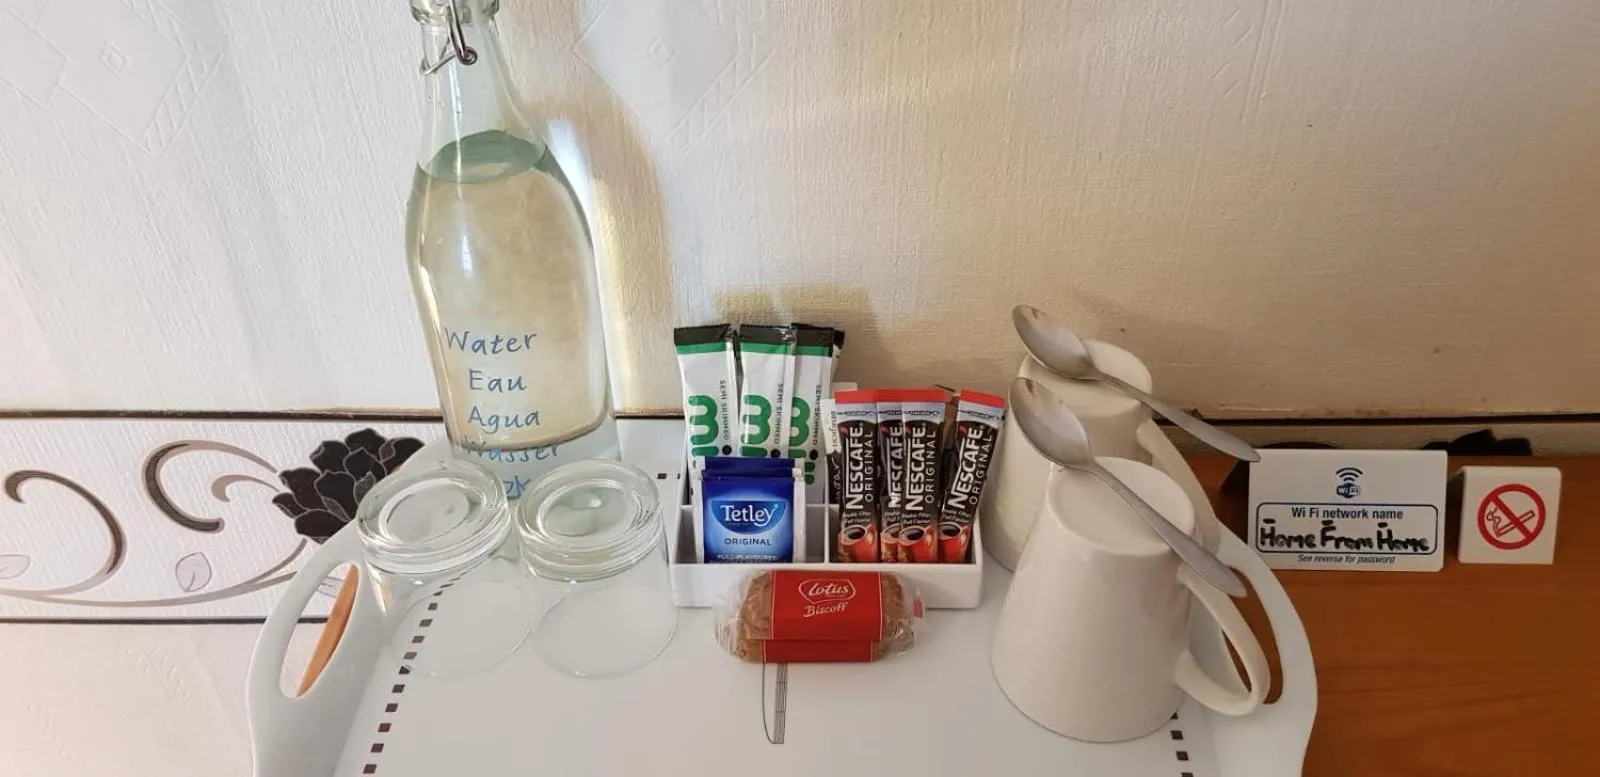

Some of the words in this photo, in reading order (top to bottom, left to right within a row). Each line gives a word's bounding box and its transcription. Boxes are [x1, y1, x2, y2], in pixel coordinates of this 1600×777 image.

[444, 326, 537, 356] Water
[469, 368, 528, 393] Eau
[468, 405, 541, 435] Agua
[864, 431, 874, 502] ORIGINAL
[925, 431, 936, 504] ORIGINAL
[970, 434, 993, 505] ORIGINAL
[720, 504, 779, 527] Tetley
[1291, 507, 1306, 518] Wi
[1309, 507, 1319, 518] Fi
[1323, 508, 1369, 519] network
[1372, 510, 1404, 520] name
[724, 538, 772, 546] ORIGINAL
[1260, 522, 1316, 548] Home
[1320, 524, 1373, 550] From
[1377, 526, 1429, 552] Home
[1298, 555, 1312, 563] See
[1345, 555, 1355, 564] for
[1357, 556, 1396, 565] password
[808, 582, 850, 596] Lotus
[803, 602, 848, 618] Biscoff
